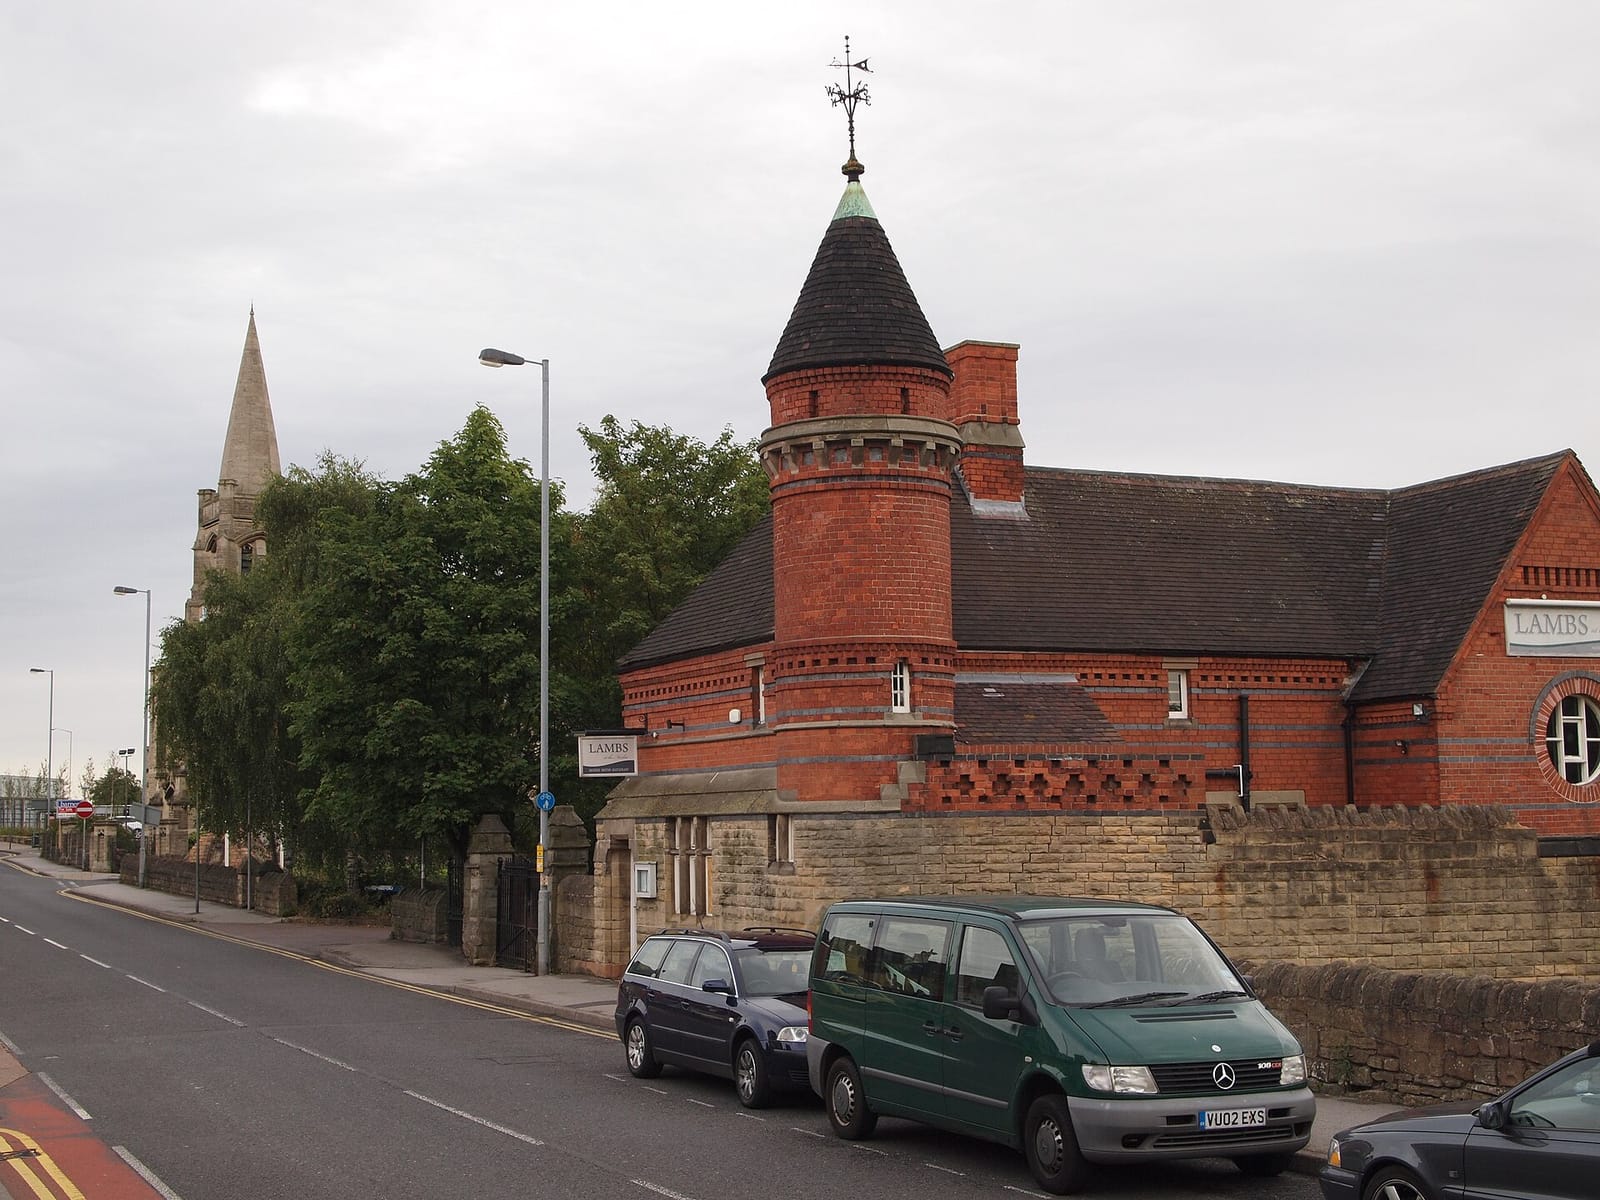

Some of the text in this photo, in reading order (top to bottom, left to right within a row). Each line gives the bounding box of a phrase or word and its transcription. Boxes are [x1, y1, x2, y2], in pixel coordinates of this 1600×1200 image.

[1514, 612, 1589, 635] LAMBS
[589, 743, 629, 753] LAMBS
[1207, 1110, 1265, 1127] VU02 EXS
